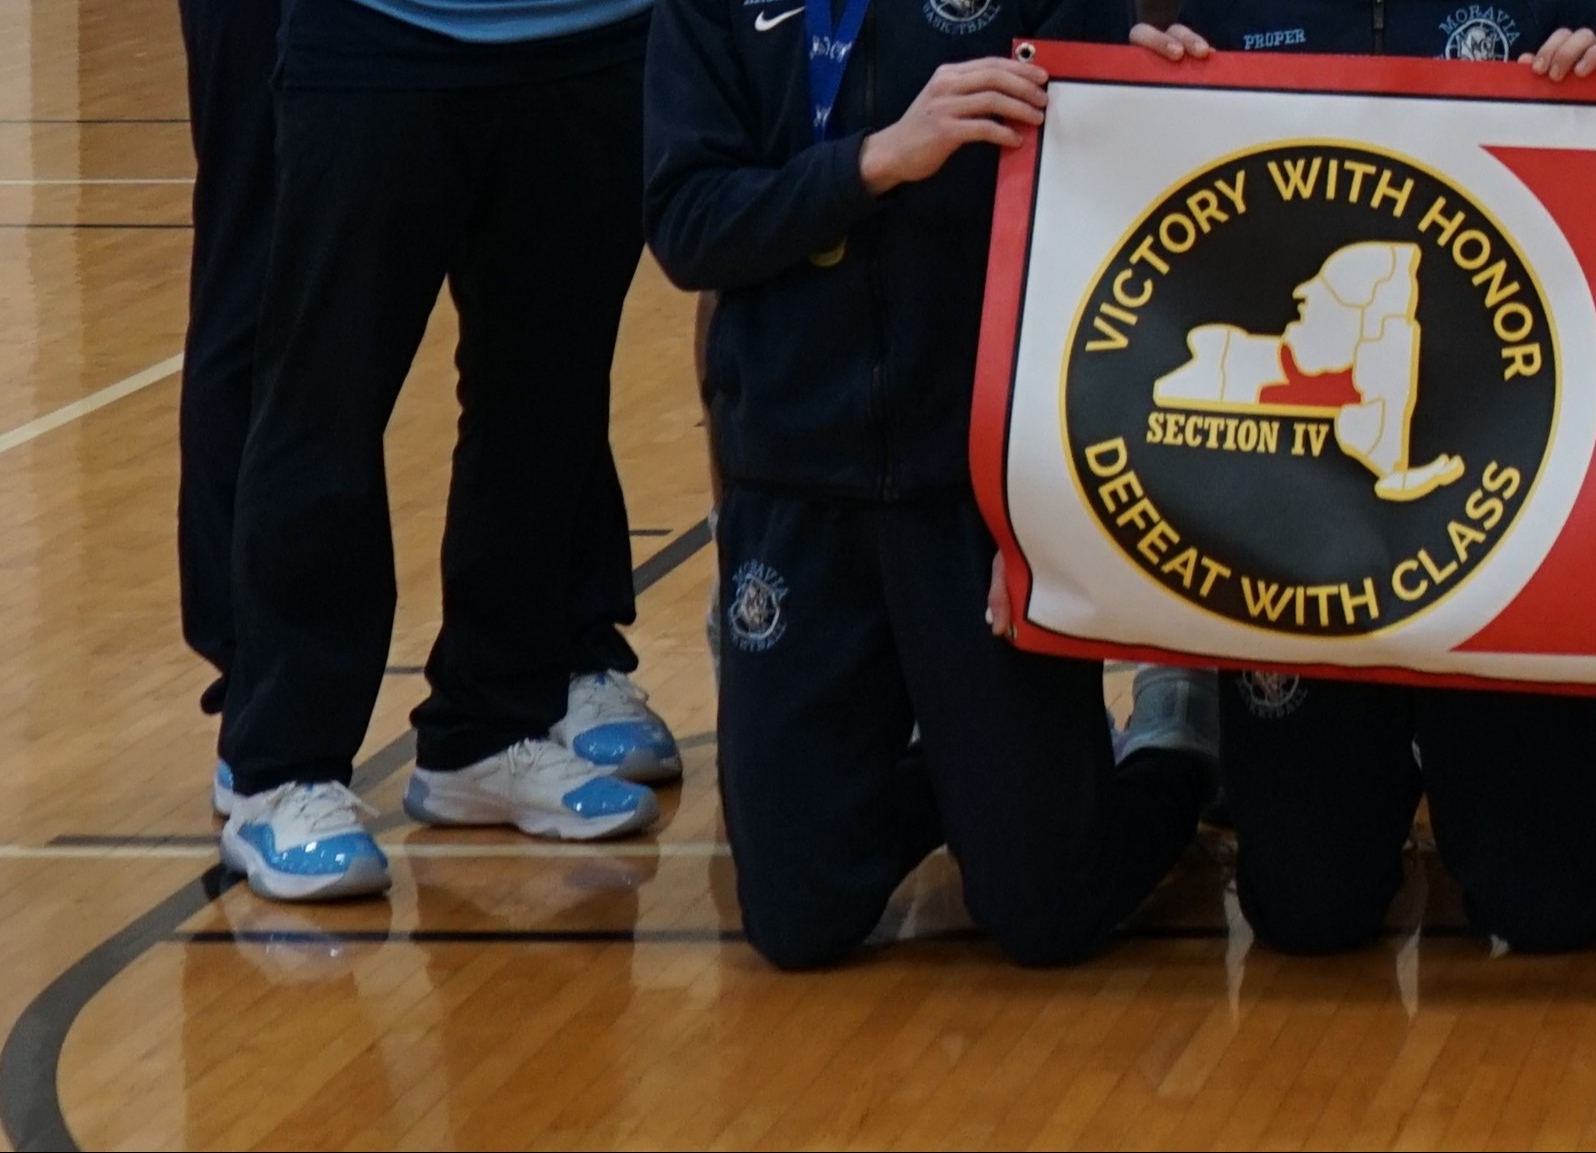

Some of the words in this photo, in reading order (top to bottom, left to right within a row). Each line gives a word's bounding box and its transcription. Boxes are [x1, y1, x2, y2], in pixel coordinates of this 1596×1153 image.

[1243, 28, 1306, 50] PROPER
[1437, 4, 1521, 45] MORAVIA
[1085, 169, 1247, 353] VICTORY
[1267, 156, 1415, 218] WITH
[1417, 195, 1543, 382] HONOR
[1145, 411, 1281, 455] SECTION
[1290, 423, 1331, 457] IV
[1084, 436, 1233, 599] DEFEAT
[1241, 576, 1381, 627] WITH
[1390, 460, 1522, 602] CLASS
